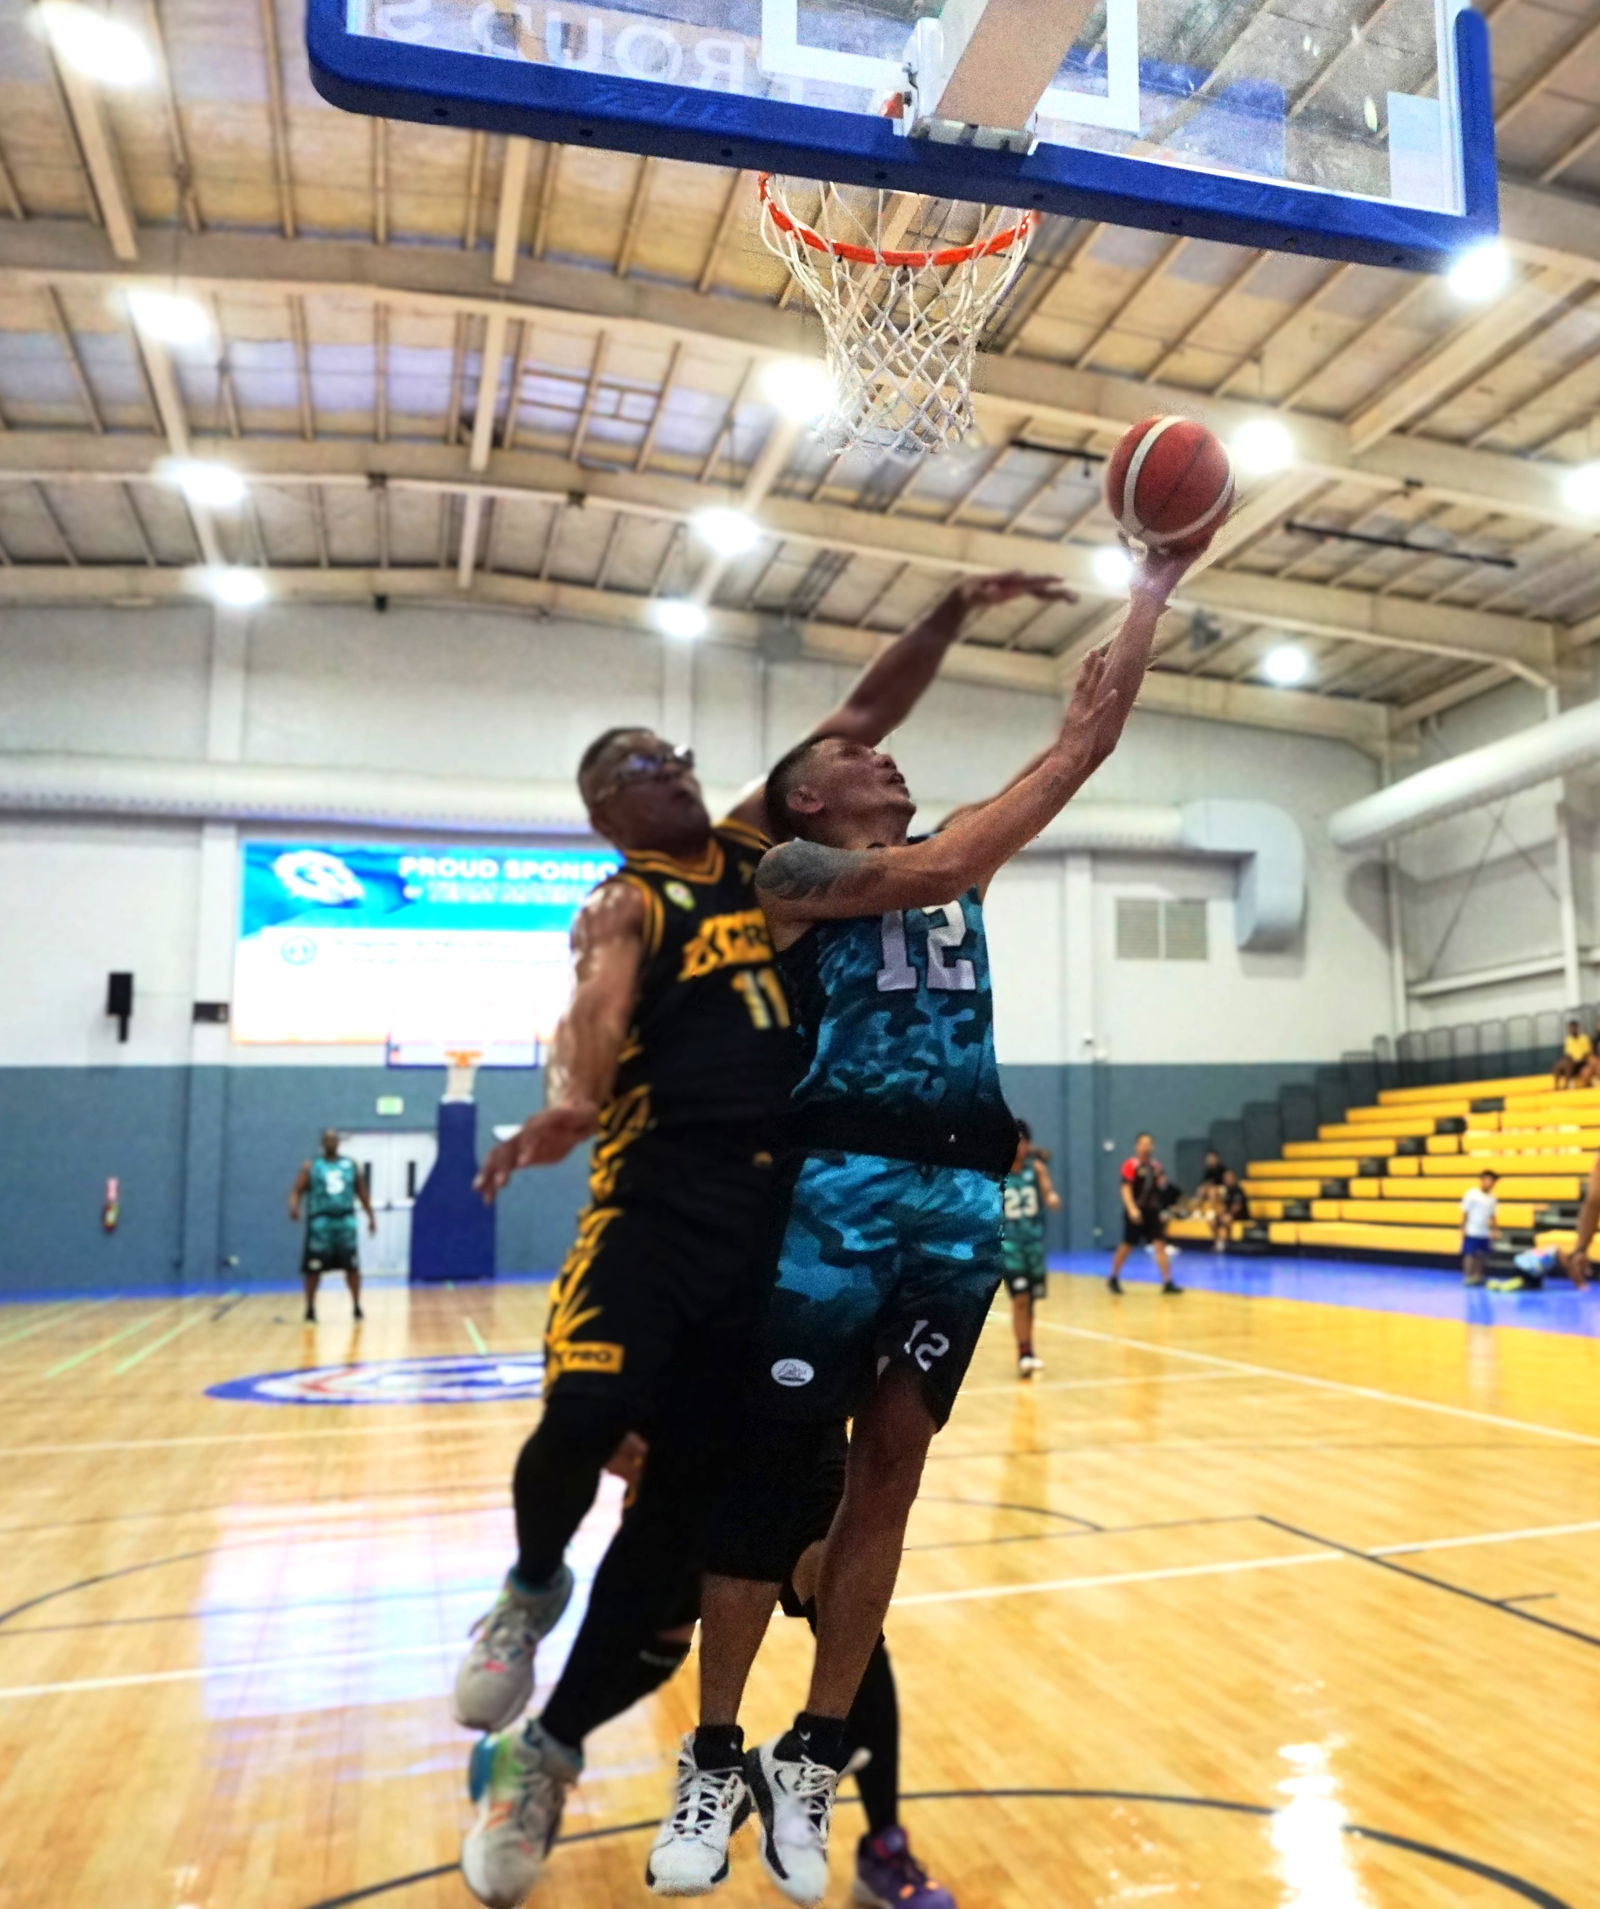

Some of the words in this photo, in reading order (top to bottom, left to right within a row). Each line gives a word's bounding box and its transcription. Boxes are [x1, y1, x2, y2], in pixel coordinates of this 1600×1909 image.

[399, 857, 499, 879] PROUD
[876, 901, 977, 992] 12
[731, 968, 791, 1029] 11
[1004, 1185, 1038, 1219] 23
